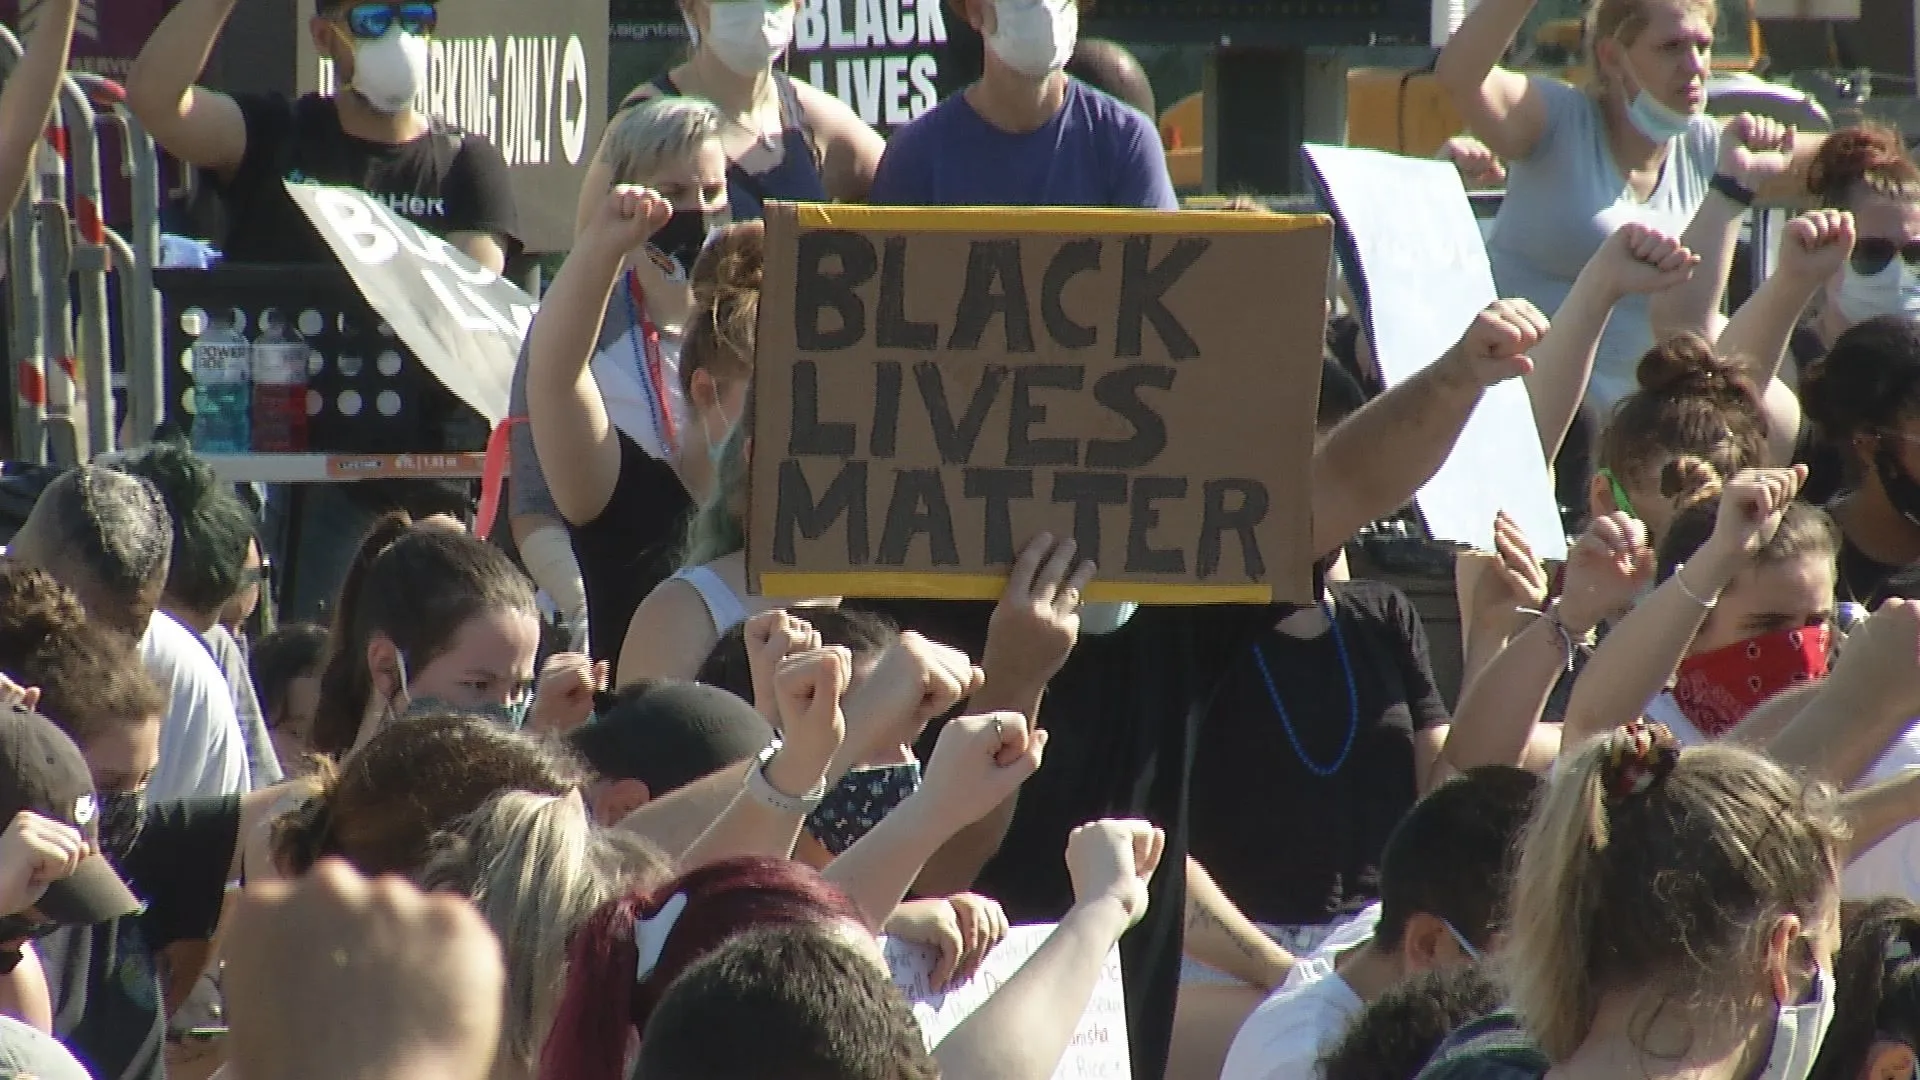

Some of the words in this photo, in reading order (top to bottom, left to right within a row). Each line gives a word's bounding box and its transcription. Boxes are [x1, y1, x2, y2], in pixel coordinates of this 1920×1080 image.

[795, 0, 948, 49] BLACK
[502, 34, 558, 167] ONLY
[794, 229, 1210, 360] BLACK
[788, 360, 1178, 467] LIVES
[772, 457, 1270, 580] MATTER
